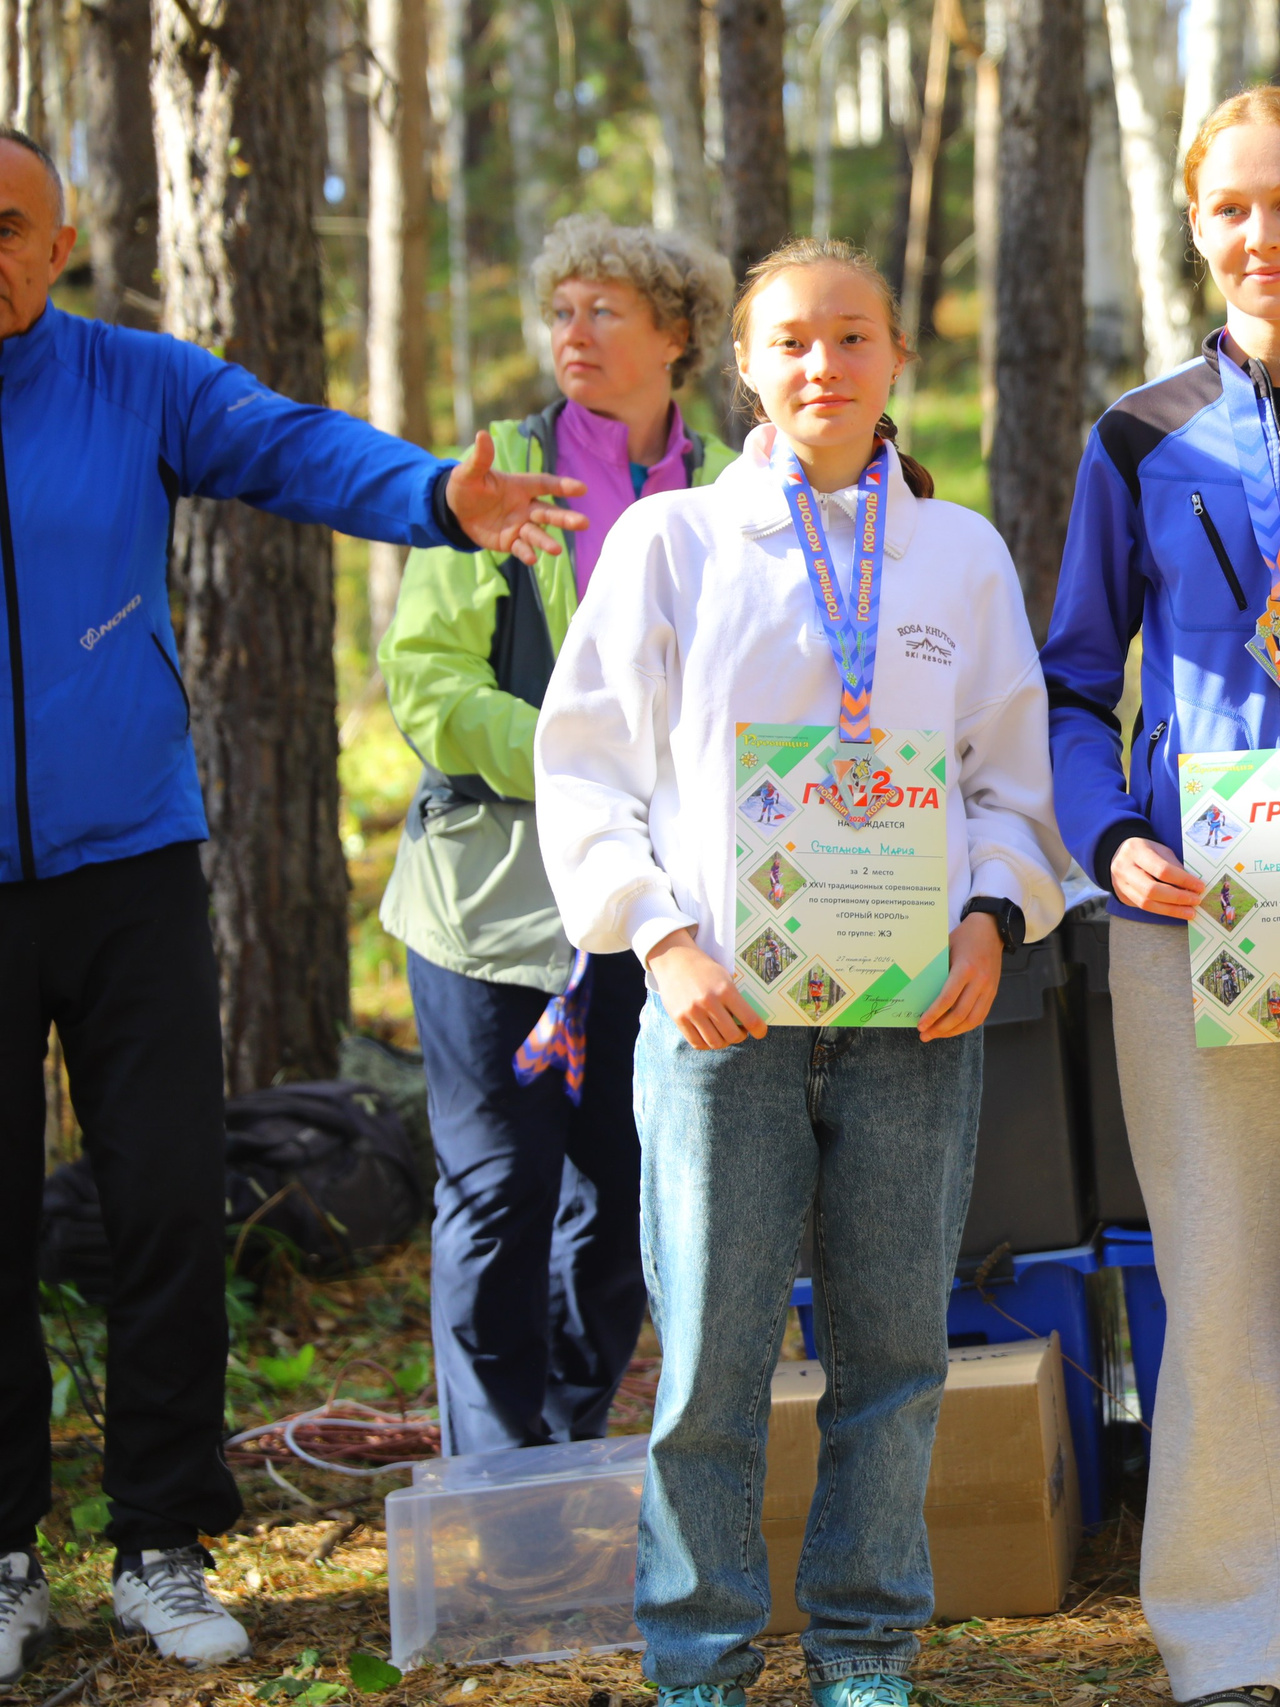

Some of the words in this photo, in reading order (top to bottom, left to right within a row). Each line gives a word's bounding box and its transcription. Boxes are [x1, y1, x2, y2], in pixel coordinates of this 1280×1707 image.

[796, 492, 822, 553] КОРОЛЬ
[862, 492, 878, 553] КОРОЛЬ
[813, 558, 841, 621] ГОРНЫЙ
[857, 559, 873, 622] ГОРНЫЙ
[99, 594, 142, 636] NORD
[897, 624, 923, 636] ROSA
[925, 625, 956, 650] KHUTOR
[922, 654, 952, 666] RESORT
[871, 770, 891, 794] 2
[816, 785, 849, 816] ГОРНЫЙ
[865, 789, 896, 817] КОРОЛЬ
[837, 820, 905, 829] НАЖДАЕТСЯ
[863, 867, 869, 875] 2
[827, 883, 883, 892] традиционных
[885, 884, 941, 892] соревнованиях
[820, 897, 870, 905] спортивному
[871, 899, 935, 907] ориентированию
[848, 930, 876, 938] группе:
[878, 930, 892, 938] ЖЭ
